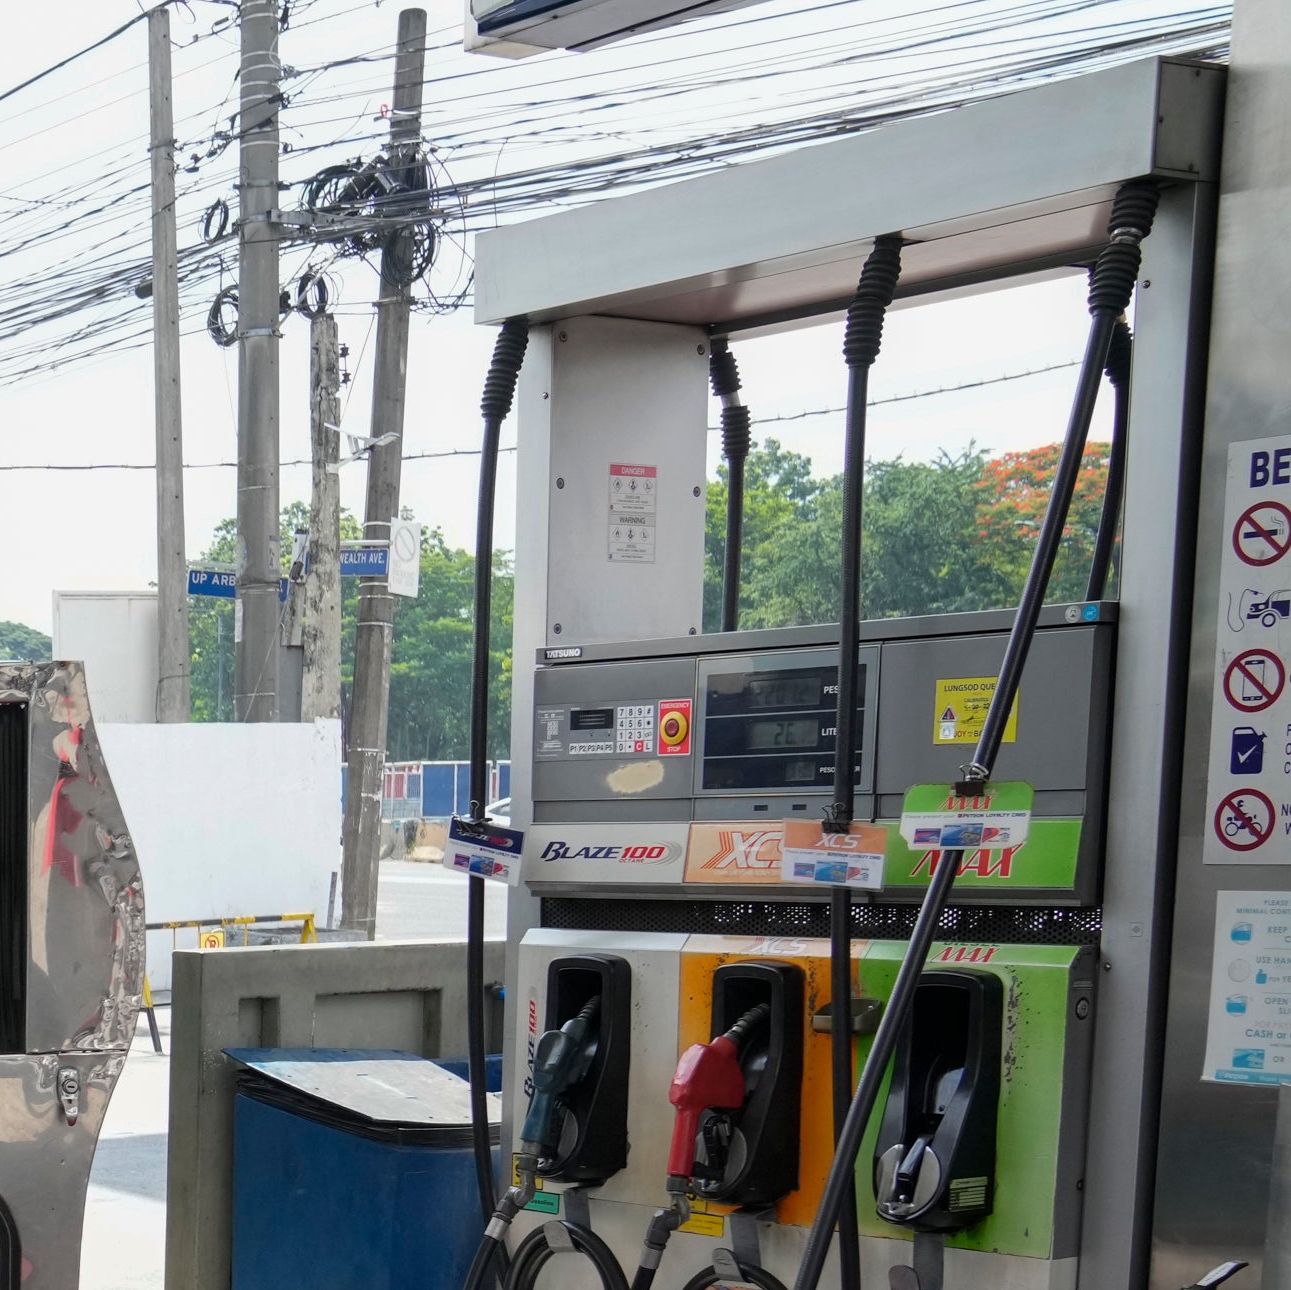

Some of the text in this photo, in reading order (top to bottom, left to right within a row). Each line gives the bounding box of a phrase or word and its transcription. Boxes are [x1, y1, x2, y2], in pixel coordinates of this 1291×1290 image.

[621, 467, 645, 475] DANGER
[619, 516, 646, 525] WARNING
[340, 552, 385, 564] WEALTH AVE.
[191, 572, 236, 587] UP ARB
[545, 647, 581, 659] TATSUNO
[823, 685, 839, 695] PES
[944, 682, 997, 693] LUNGSOD QUE
[660, 702, 690, 710] EMERGENCY
[619, 708, 624, 717] 7
[628, 708, 633, 716] 8
[637, 707, 642, 716] 9
[619, 719, 642, 728] 4 5 6
[628, 731, 633, 739] 2
[637, 731, 642, 739] 3
[821, 727, 837, 737] LITE
[938, 795, 996, 812] MAX
[815, 832, 862, 849] XCS
[707, 831, 784, 870] XC
[1270, 908, 1291, 916] CONT
[1267, 926, 1288, 934] KEEP
[930, 946, 1003, 963] MAX
[1256, 956, 1291, 964] USE HAN
[1264, 997, 1288, 1006] OPEN
[1245, 1028, 1286, 1040] CASH or
[1272, 1056, 1285, 1064] OR
